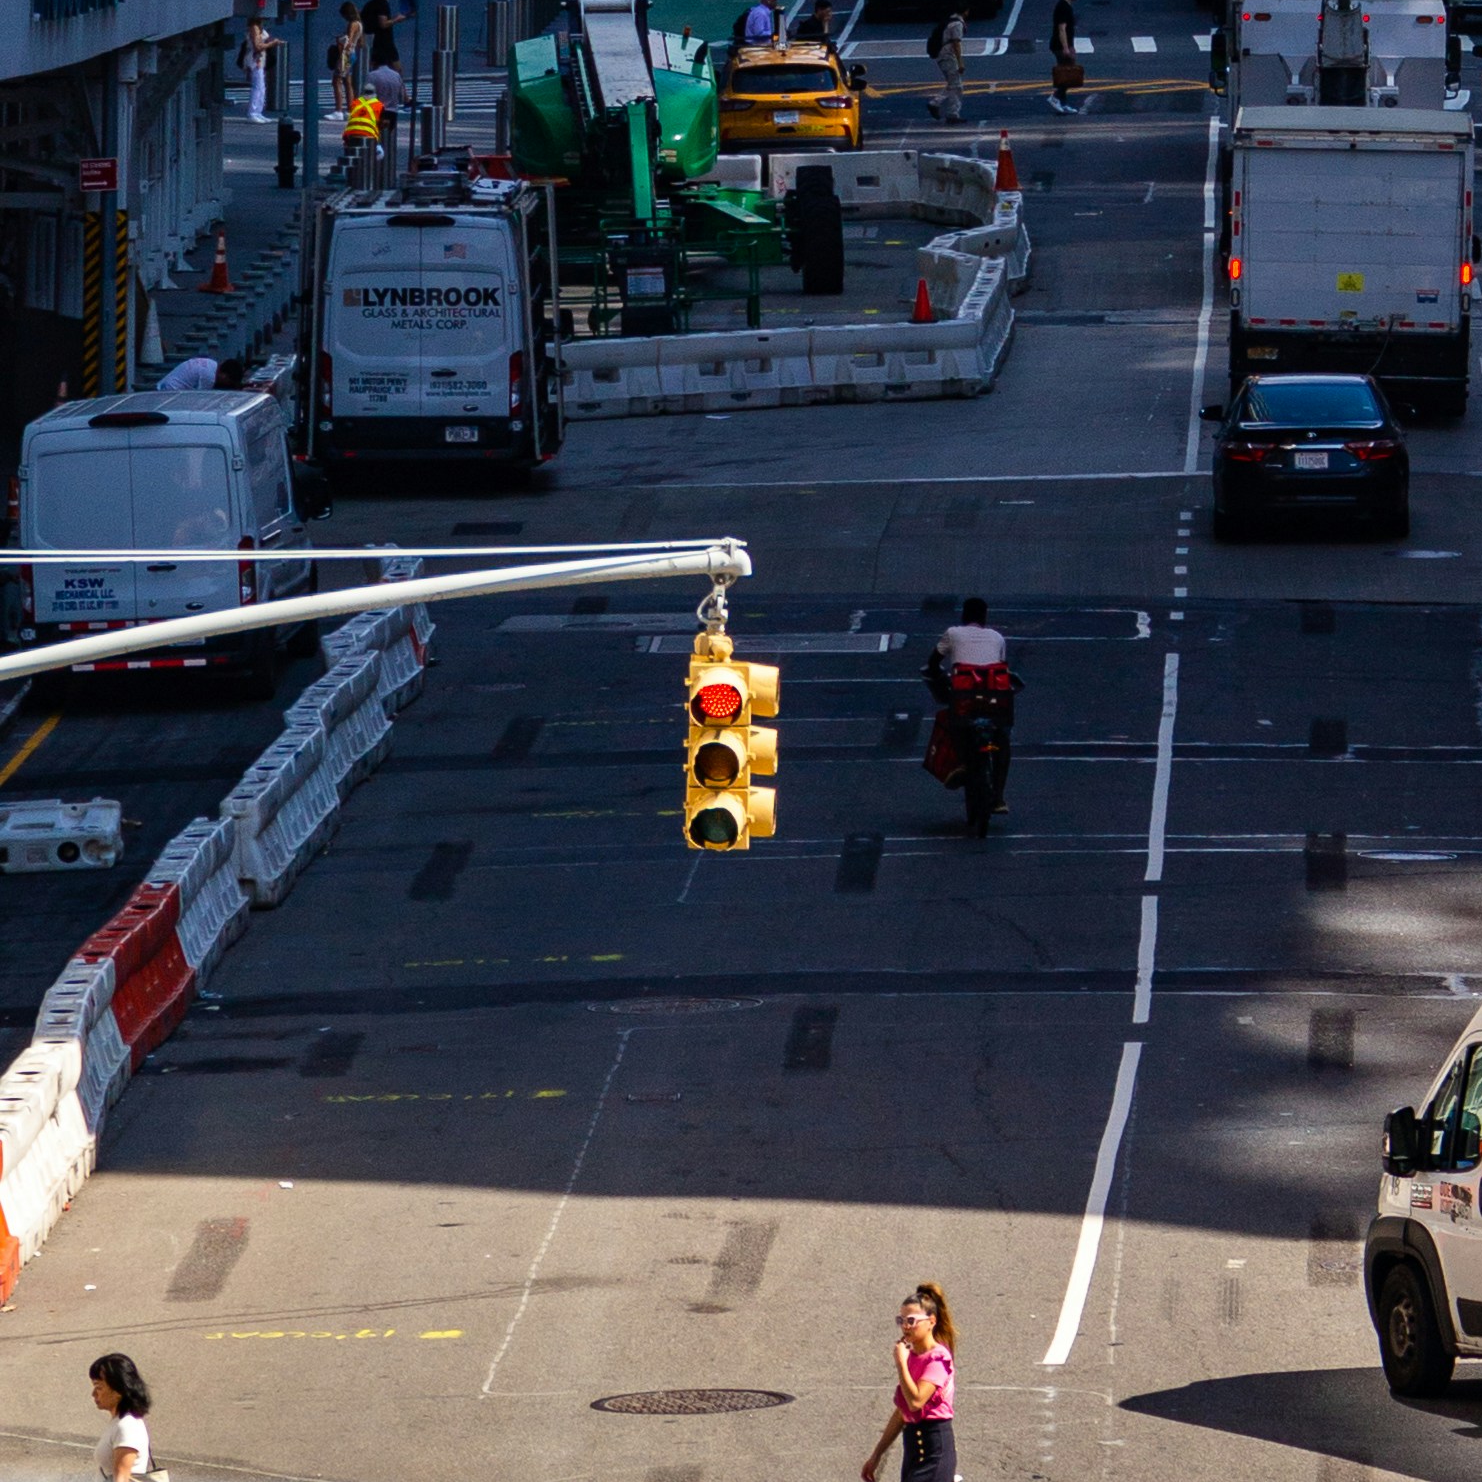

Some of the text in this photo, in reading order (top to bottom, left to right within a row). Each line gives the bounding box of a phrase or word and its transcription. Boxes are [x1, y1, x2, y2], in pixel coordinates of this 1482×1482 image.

[362, 287, 500, 307] LYNBROOK
[362, 308, 501, 318] GLASS & ARCHITECTURAL
[391, 320, 468, 330] METALS CORP.
[64, 578, 104, 589] KSW
[55, 589, 99, 600] MECHANICAL
